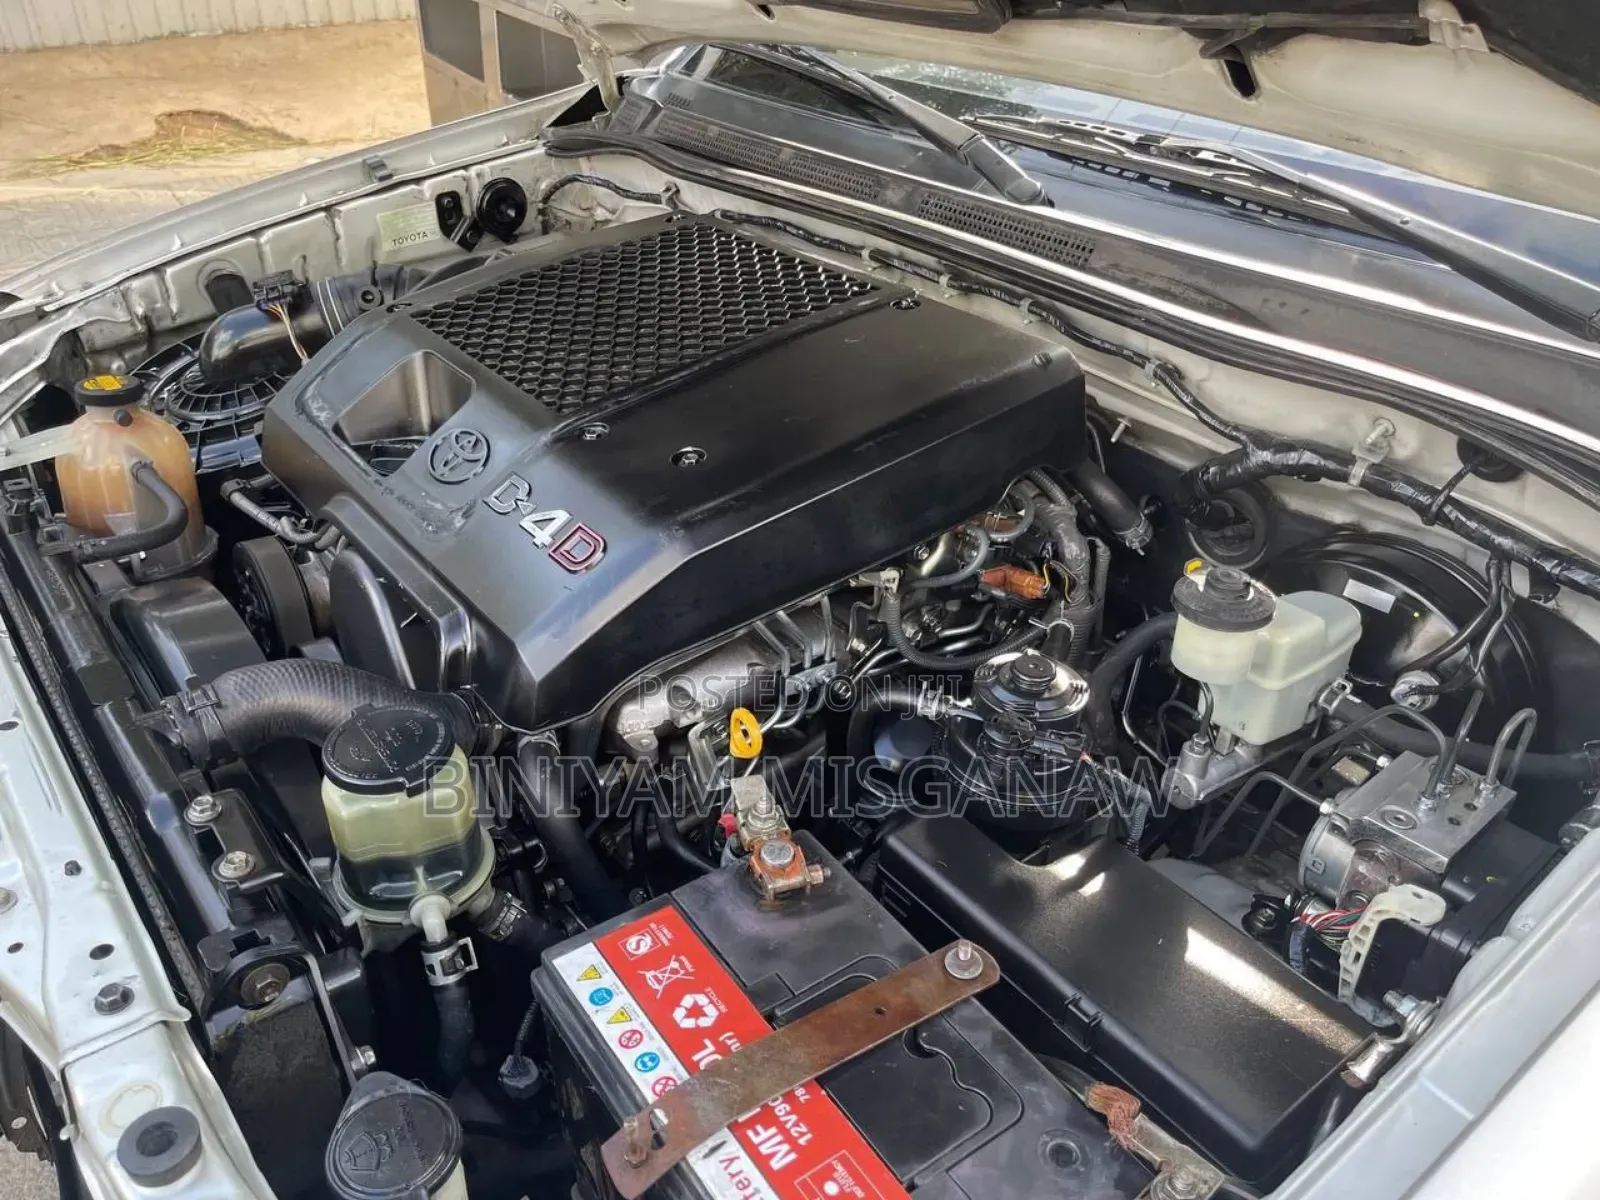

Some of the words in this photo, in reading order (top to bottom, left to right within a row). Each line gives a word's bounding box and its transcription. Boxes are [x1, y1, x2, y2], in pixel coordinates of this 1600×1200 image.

[392, 232, 428, 246] TOYOTA
[704, 986, 729, 1014] RECYCLE
[768, 1095, 813, 1146] 12V90
[746, 1123, 798, 1172] MF
[719, 1153, 765, 1200] tery
